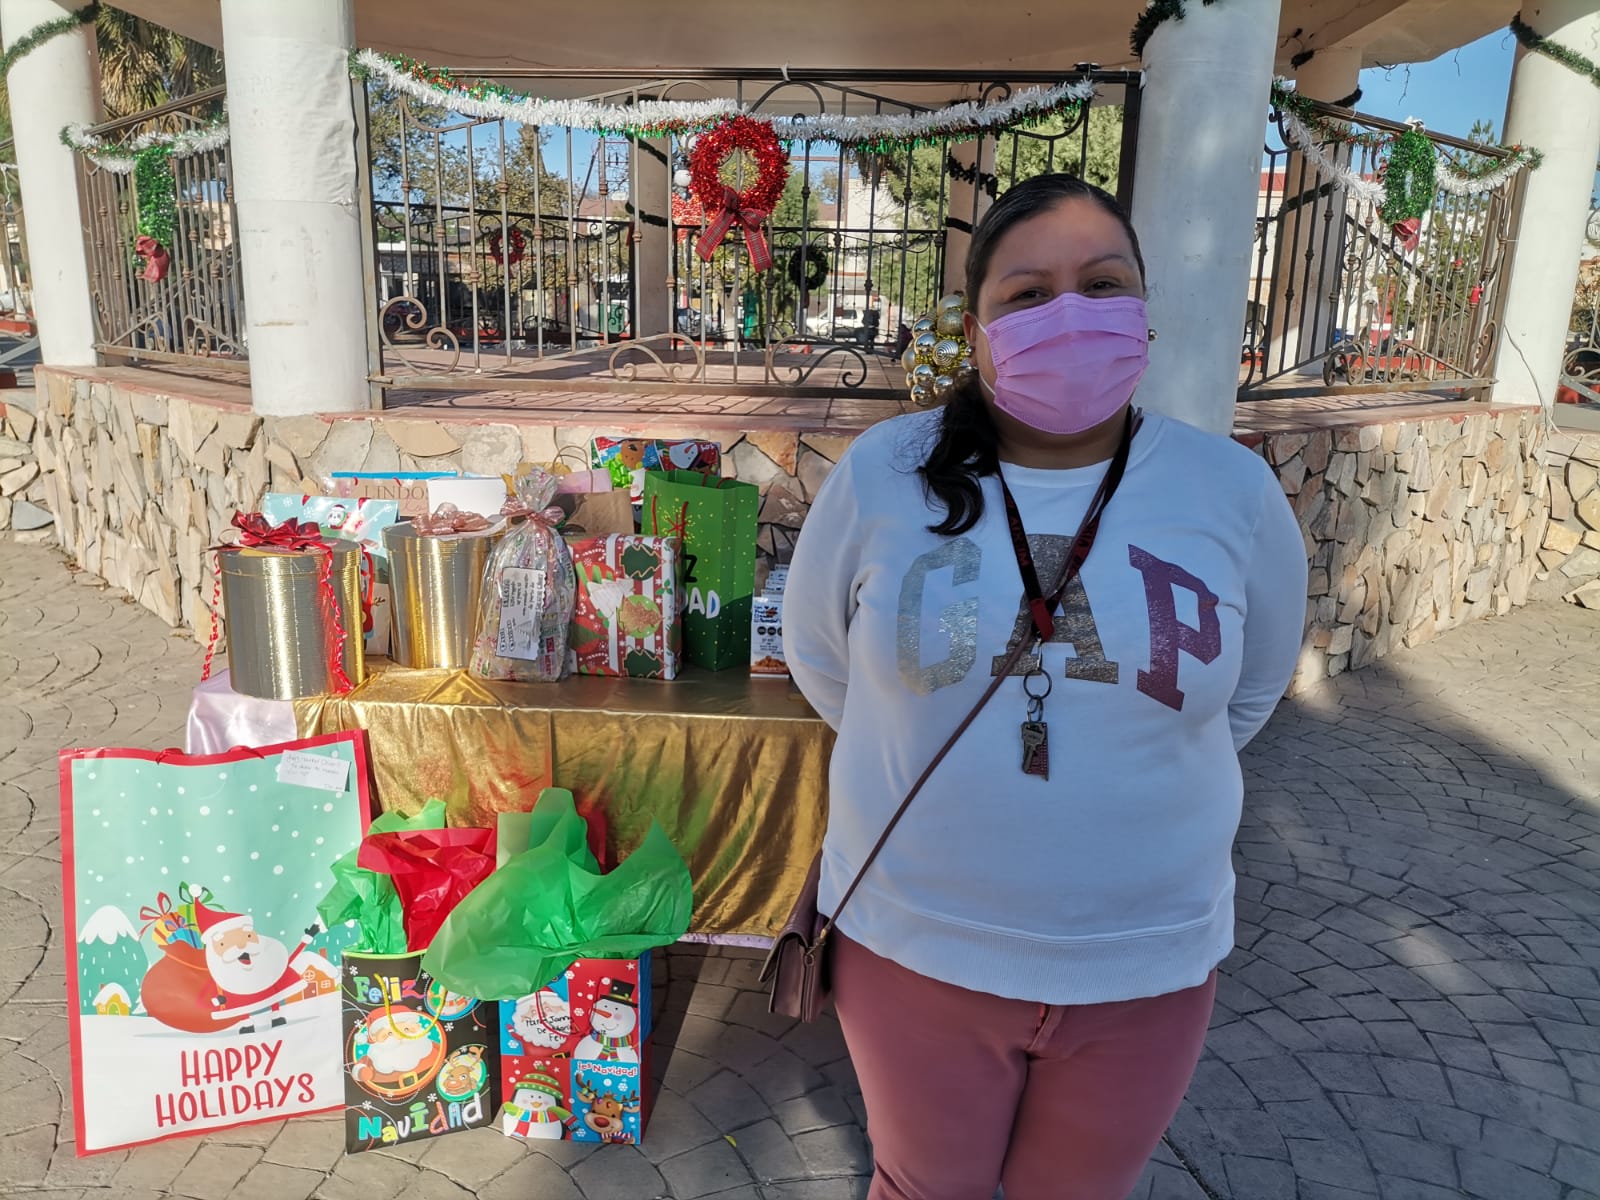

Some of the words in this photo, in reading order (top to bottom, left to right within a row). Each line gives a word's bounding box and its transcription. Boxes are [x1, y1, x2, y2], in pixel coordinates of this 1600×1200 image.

[896, 533, 1222, 712] GAP
[353, 976, 427, 1003] Feliz
[181, 1039, 283, 1087] HAPPY
[155, 1073, 315, 1128] HOLIDAYS
